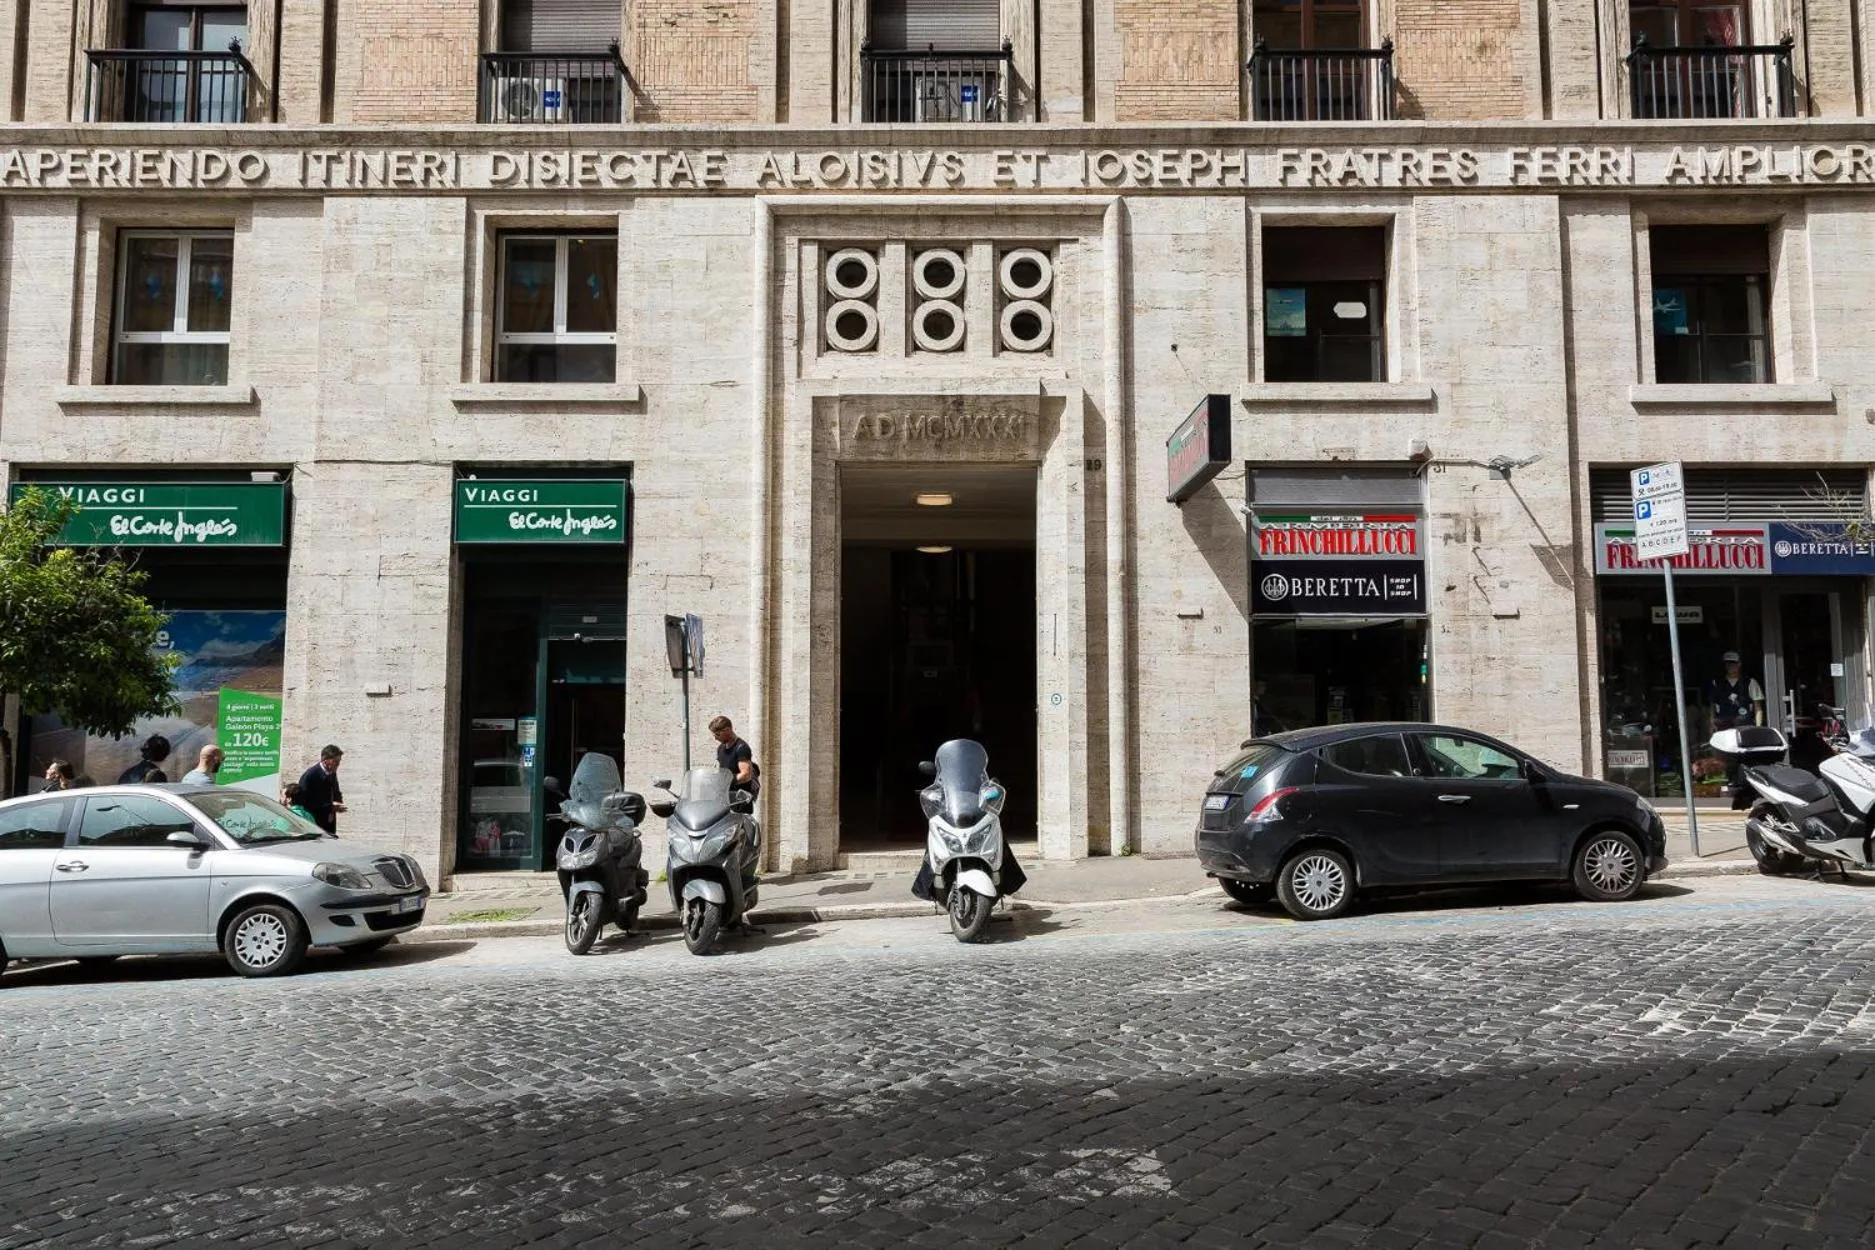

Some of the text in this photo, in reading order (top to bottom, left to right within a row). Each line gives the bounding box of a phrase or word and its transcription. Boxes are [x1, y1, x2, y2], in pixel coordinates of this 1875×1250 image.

[3, 145, 1875, 183] APERIENDO ITINERI DISIECTAE ALOISIVS ET IOSEPH FRATRES FERRI AMPLIOR
[59, 486, 145, 503] VIAGGI
[464, 487, 539, 502] VIAGGI
[110, 515, 131, 535] El
[130, 514, 174, 536] Corte
[509, 512, 526, 530] El
[525, 512, 563, 530] Corte
[1259, 528, 1416, 555] FRINCHILLUCCI
[1792, 542, 1849, 555] BERETTA
[1291, 578, 1380, 597] BERETTA
